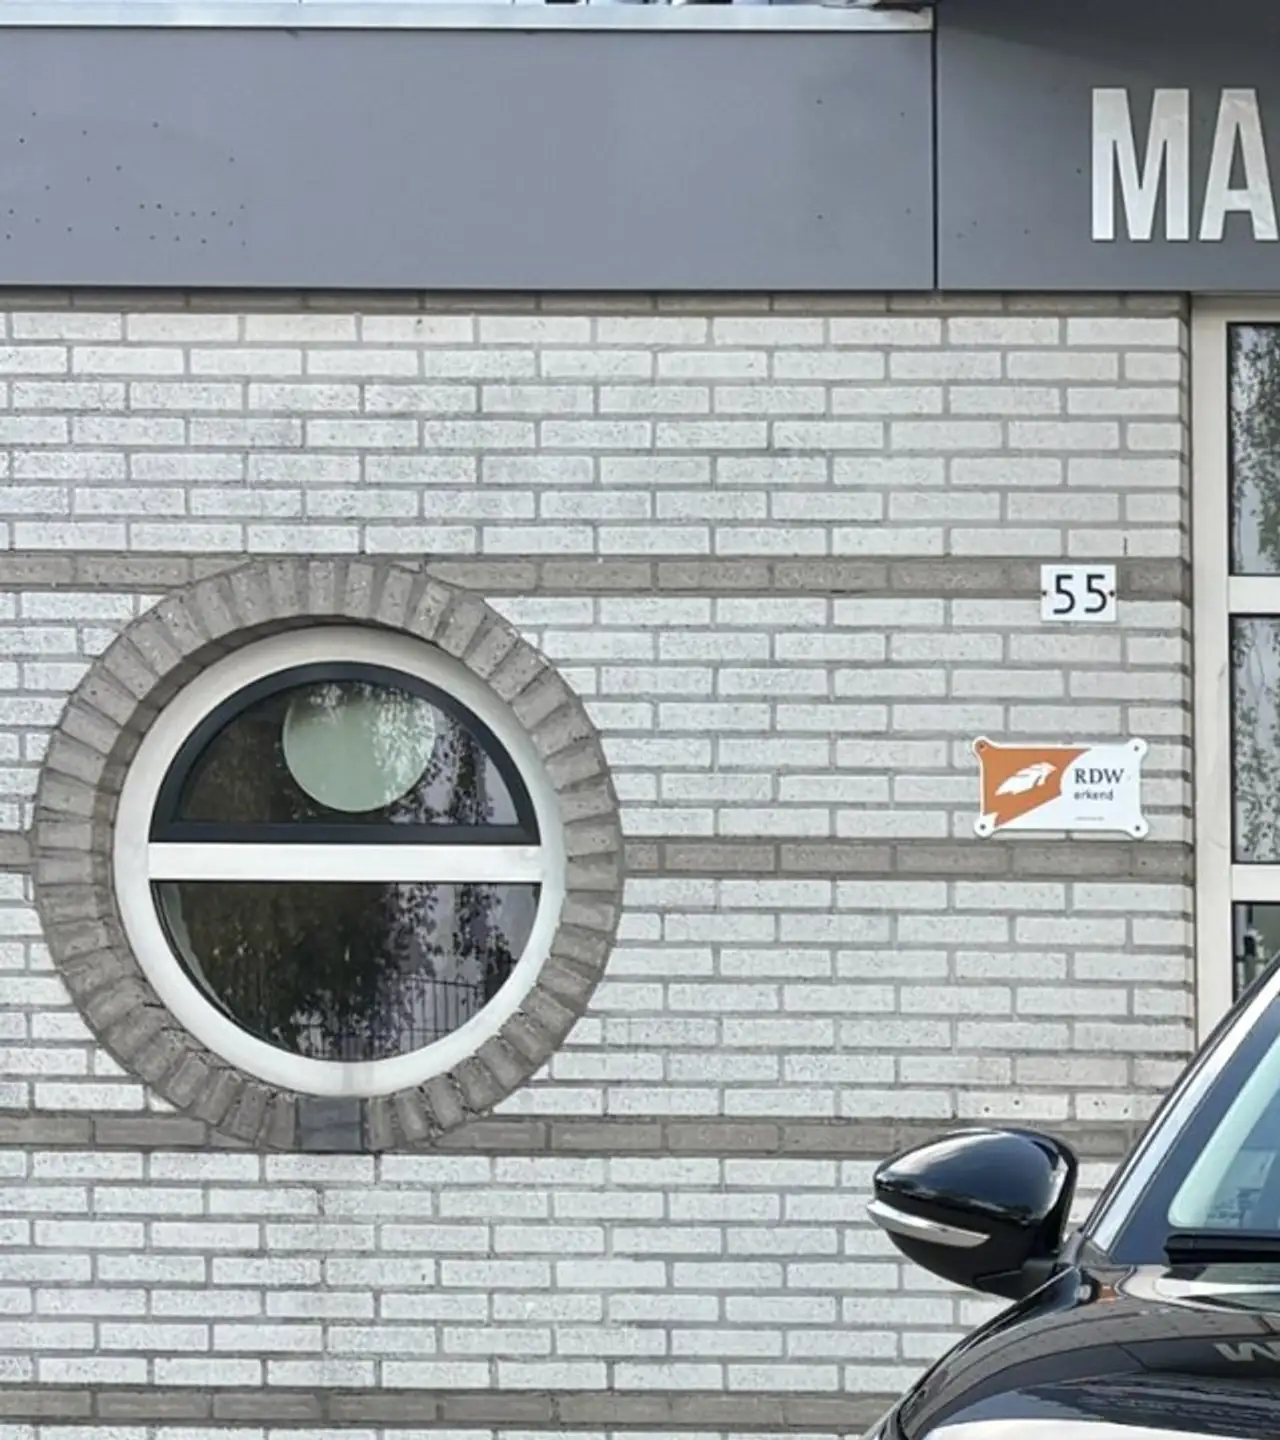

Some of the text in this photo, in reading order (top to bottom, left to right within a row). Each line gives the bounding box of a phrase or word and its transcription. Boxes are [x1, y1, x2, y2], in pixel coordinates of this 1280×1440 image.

[1052, 574, 1108, 615] 55
[1074, 767, 1124, 784] RDW
[1073, 788, 1115, 802] erkend
